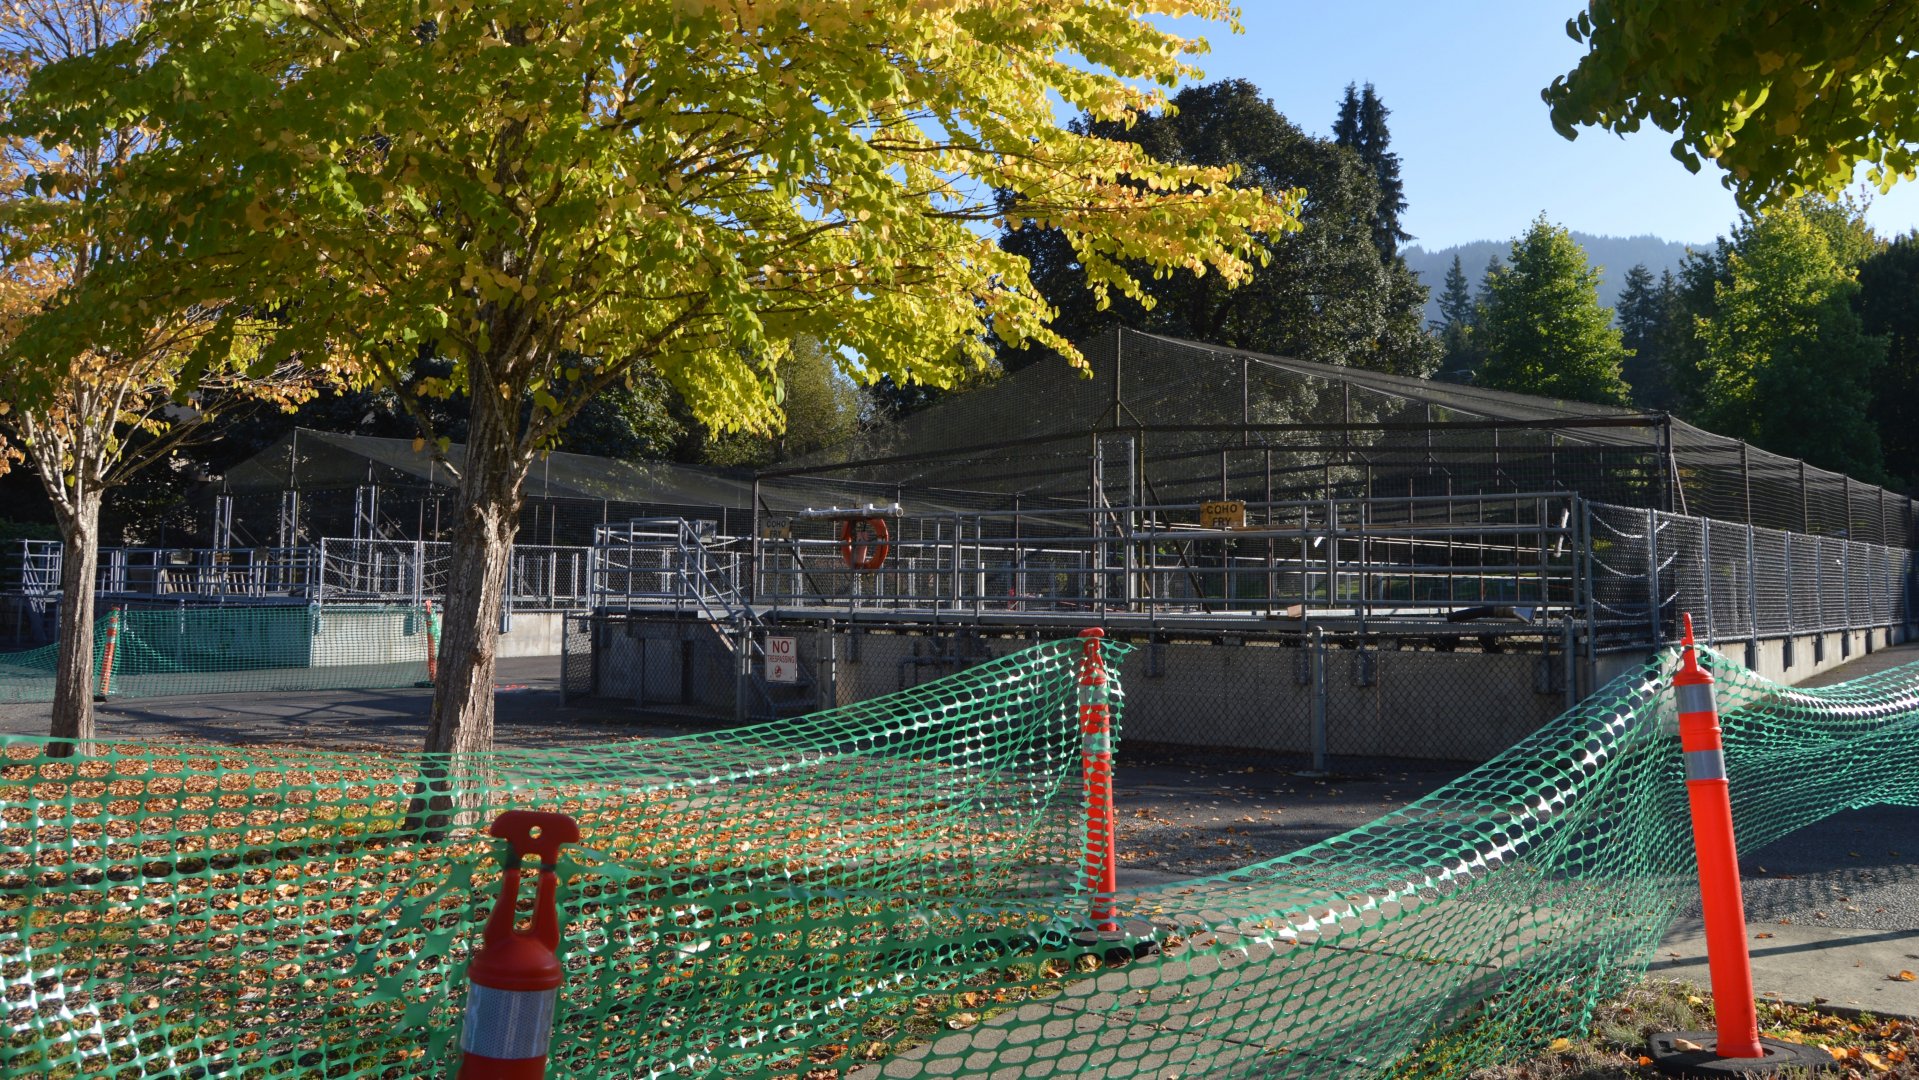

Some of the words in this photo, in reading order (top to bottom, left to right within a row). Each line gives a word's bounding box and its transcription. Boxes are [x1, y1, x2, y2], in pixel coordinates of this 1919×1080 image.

[1206, 504, 1237, 514] COHO
[1212, 517, 1231, 527] FRY
[773, 641, 790, 653] NO
